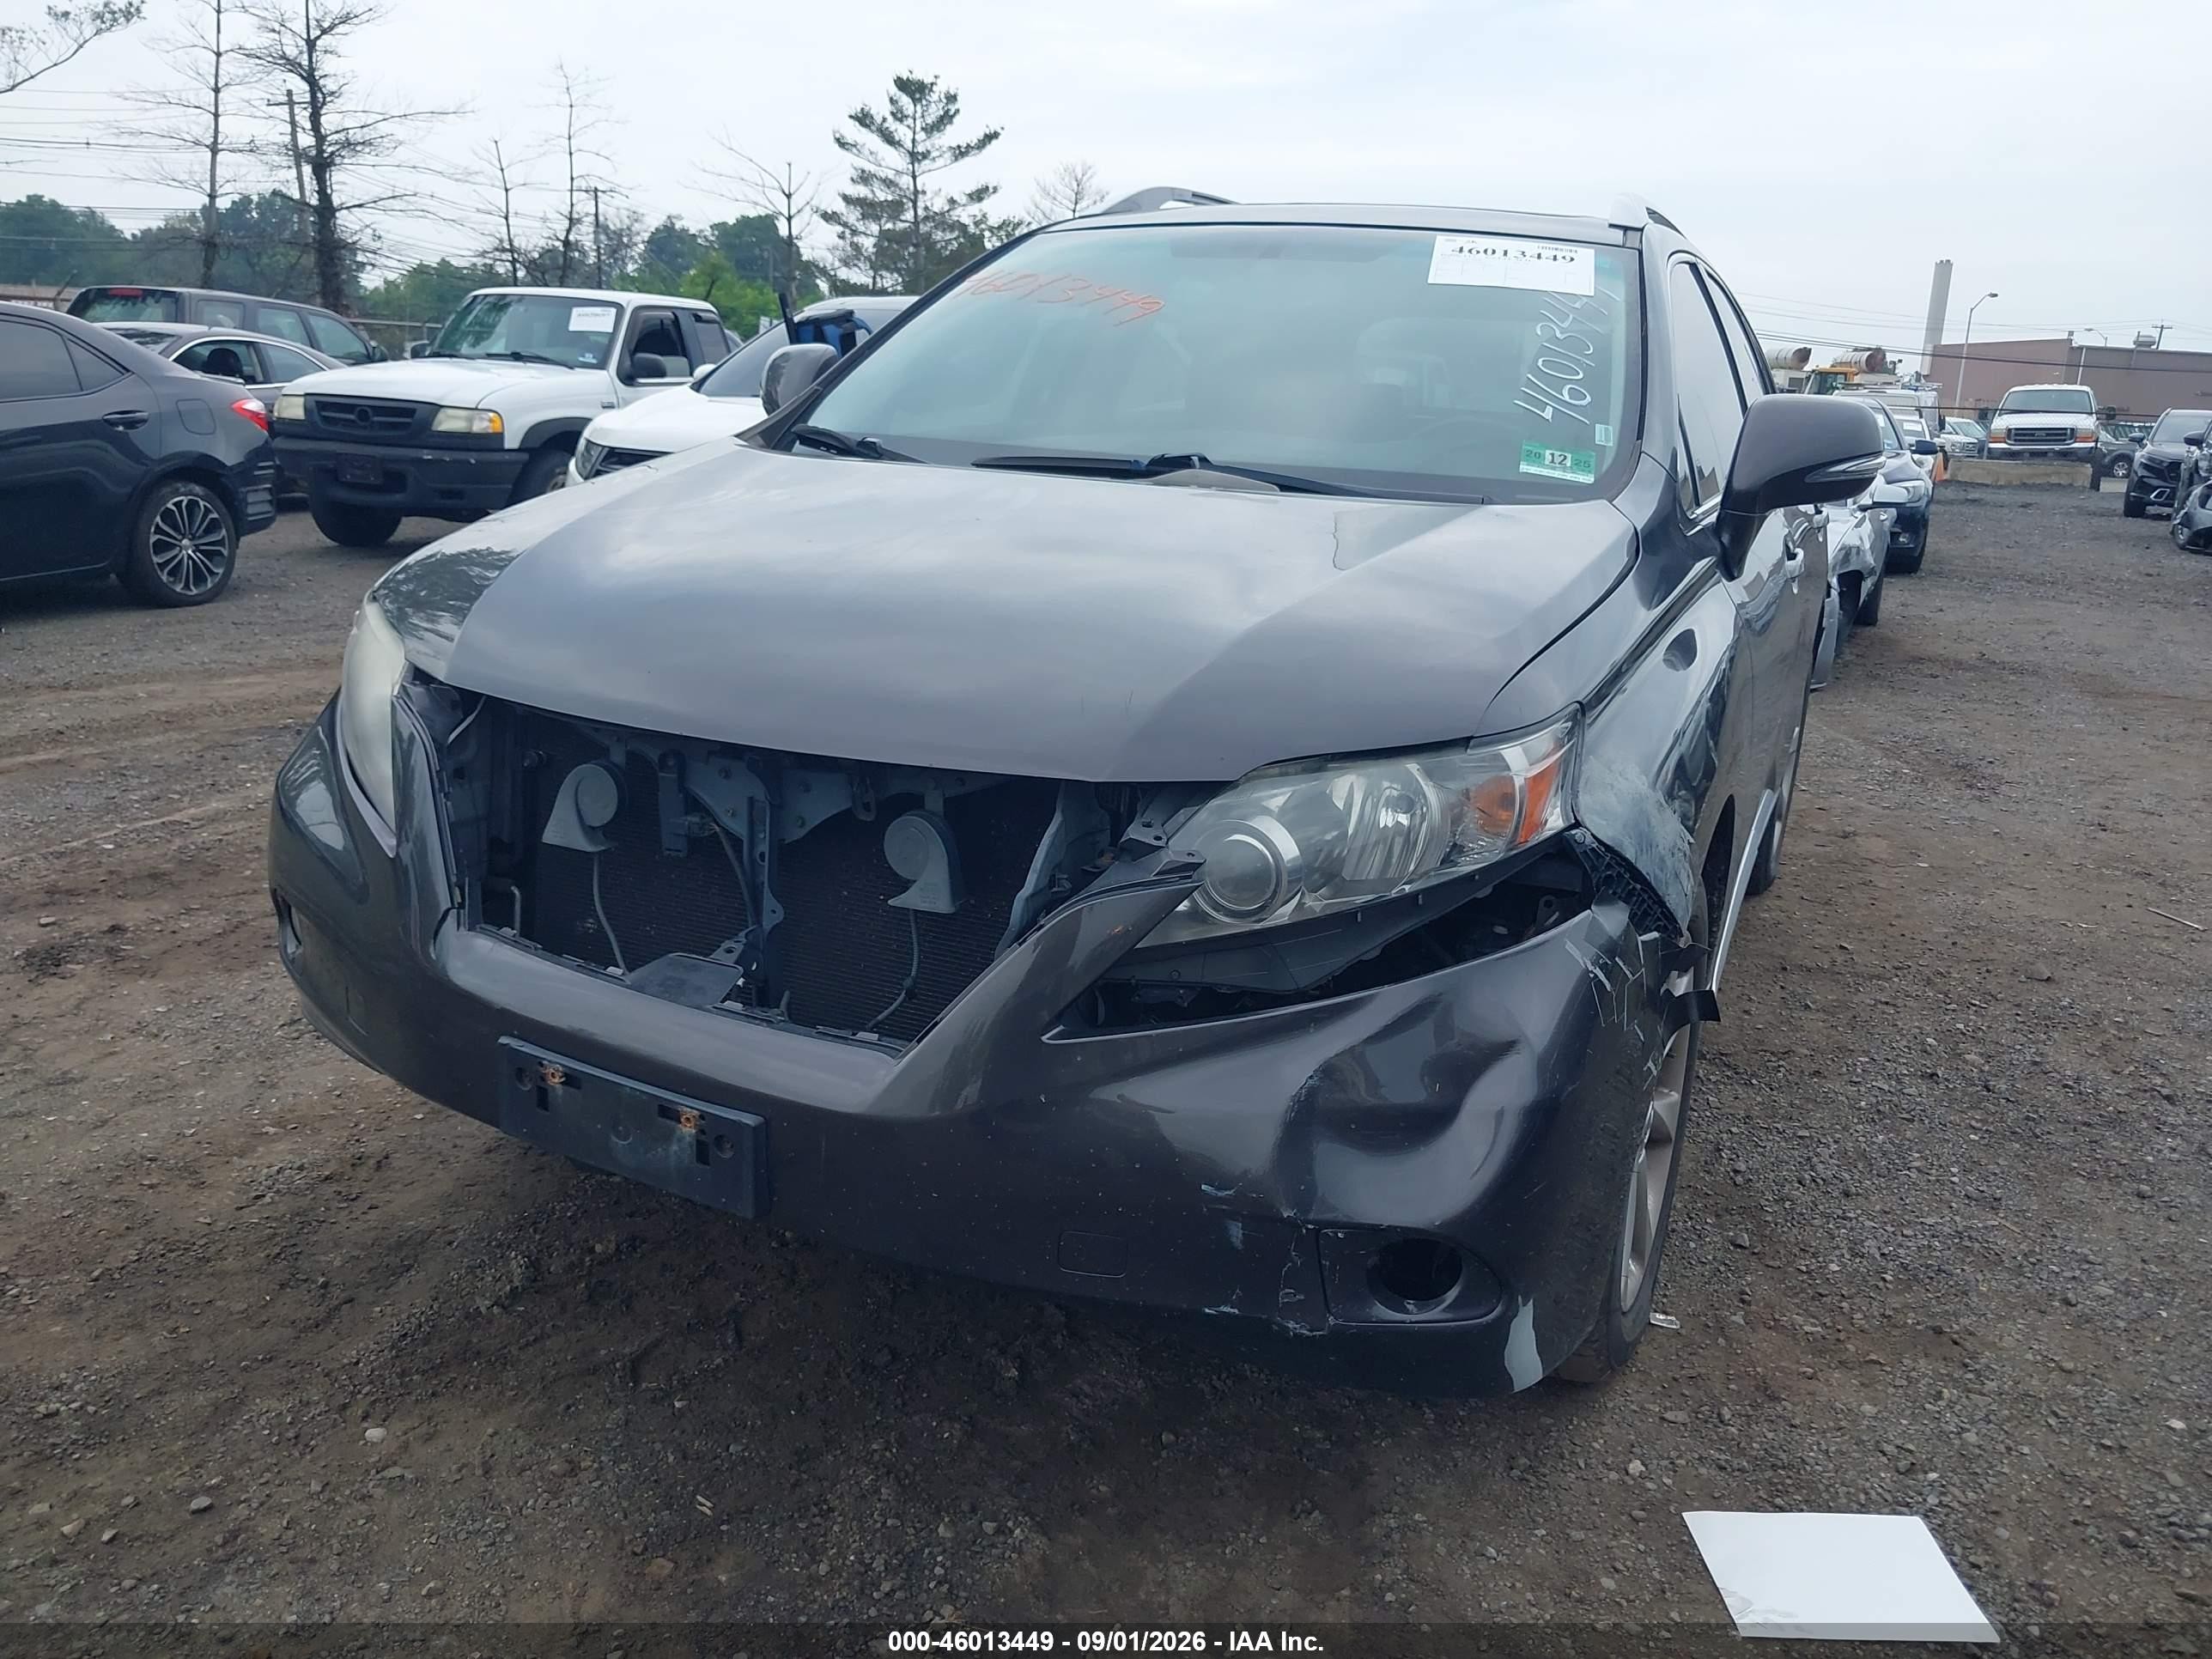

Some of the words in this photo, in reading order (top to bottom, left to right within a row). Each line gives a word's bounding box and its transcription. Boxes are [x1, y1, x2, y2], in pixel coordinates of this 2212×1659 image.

[1451, 246, 1576, 264] 46013449
[1525, 449, 1541, 460] 20
[1548, 452, 1568, 466] 12
